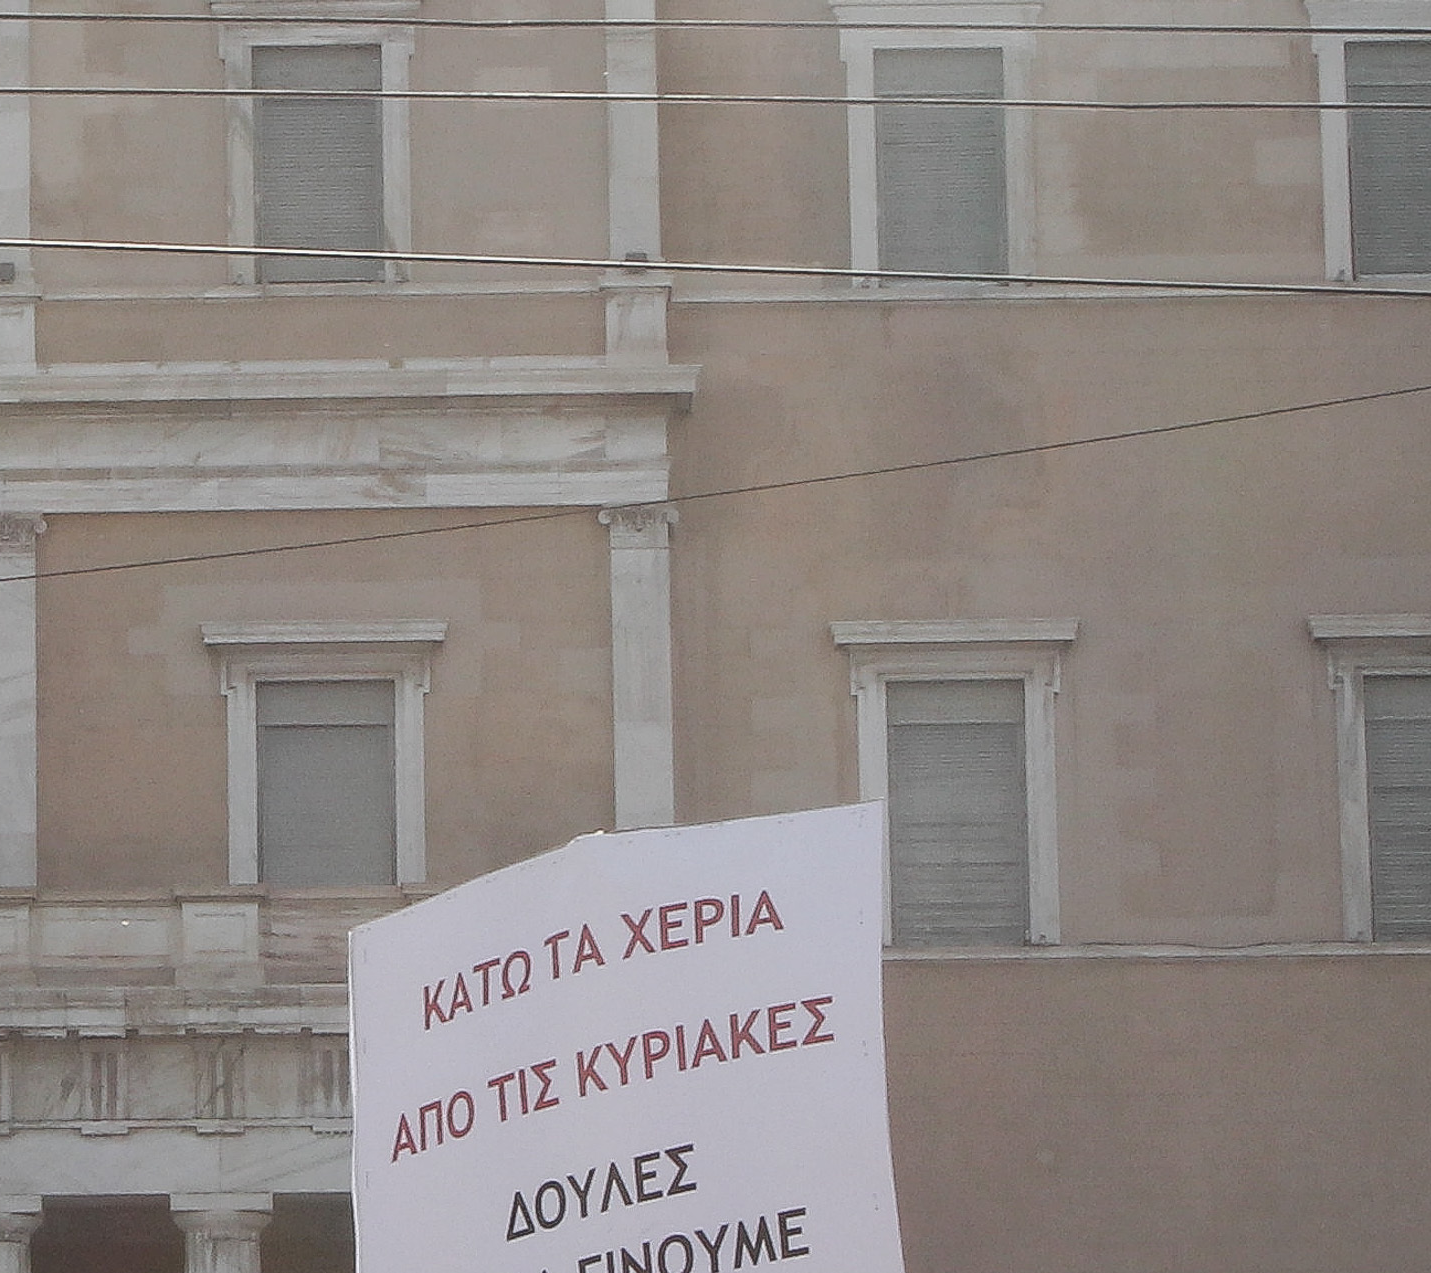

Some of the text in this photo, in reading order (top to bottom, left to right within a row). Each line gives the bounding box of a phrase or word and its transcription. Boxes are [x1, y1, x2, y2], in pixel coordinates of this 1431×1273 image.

[421, 890, 784, 1030] ΚΑΤΩ ΤΑ ΧΕΡΙΑ
[390, 995, 835, 1164] ΑΠΟ ΤΙΣ ΚΥΡΙΑΚΕΣ
[506, 1143, 698, 1242] ΔΟΥΛΕΣ
